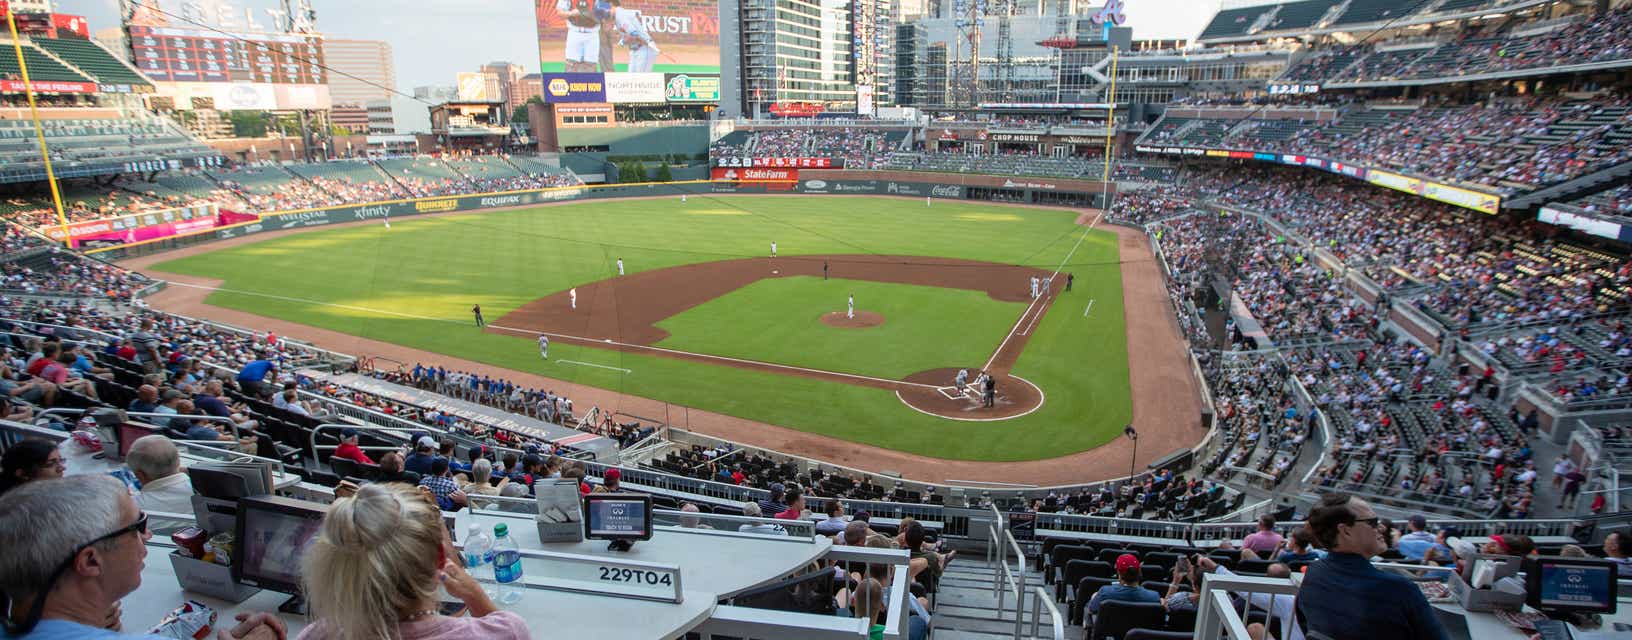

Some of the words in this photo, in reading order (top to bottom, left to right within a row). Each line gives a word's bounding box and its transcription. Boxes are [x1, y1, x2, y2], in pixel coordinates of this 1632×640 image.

[1014, 134, 1039, 142] HOUSE
[480, 195, 520, 206] EQUIFAX
[354, 205, 391, 219] xfinity
